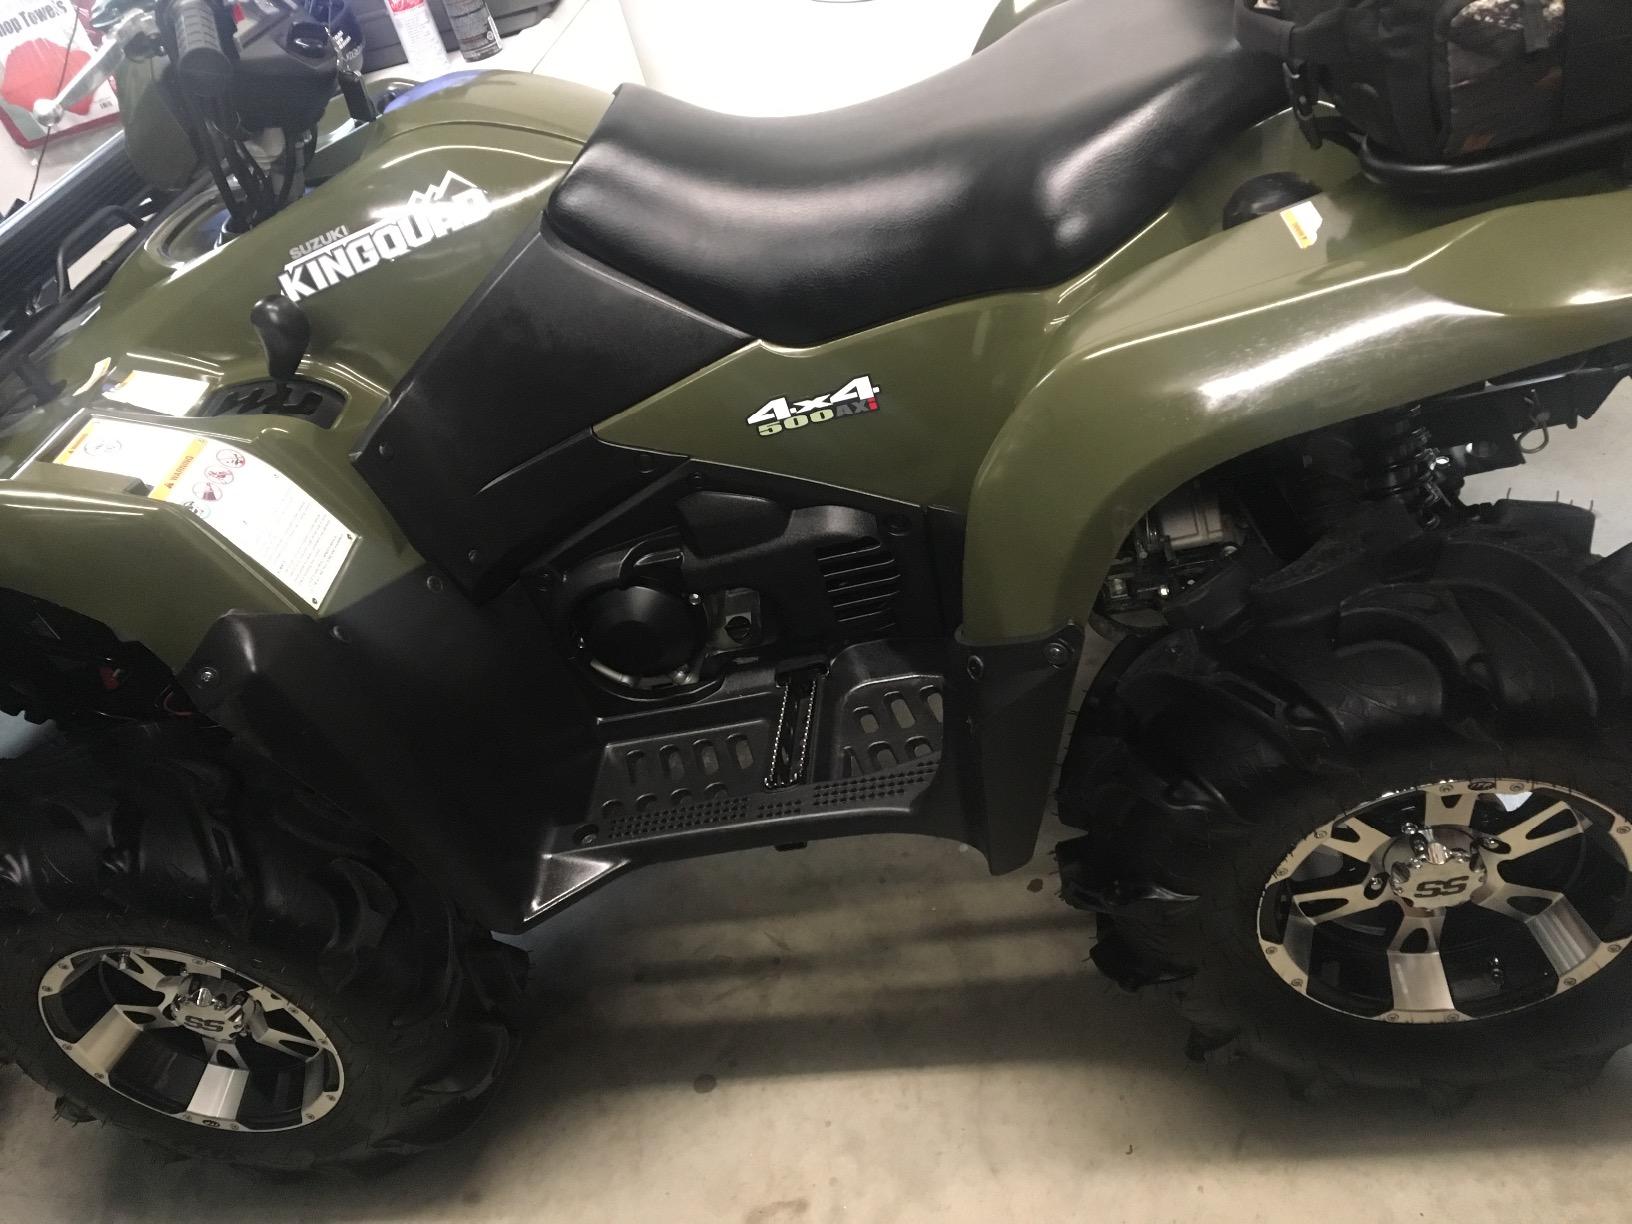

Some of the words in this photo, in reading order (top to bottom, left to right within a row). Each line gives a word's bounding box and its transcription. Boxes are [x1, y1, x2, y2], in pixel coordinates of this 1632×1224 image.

[278, 187, 491, 302] KINGQUAD
[289, 225, 350, 260] SUZUKI
[1414, 876, 1470, 898] SS
[184, 1015, 225, 1032] SS
